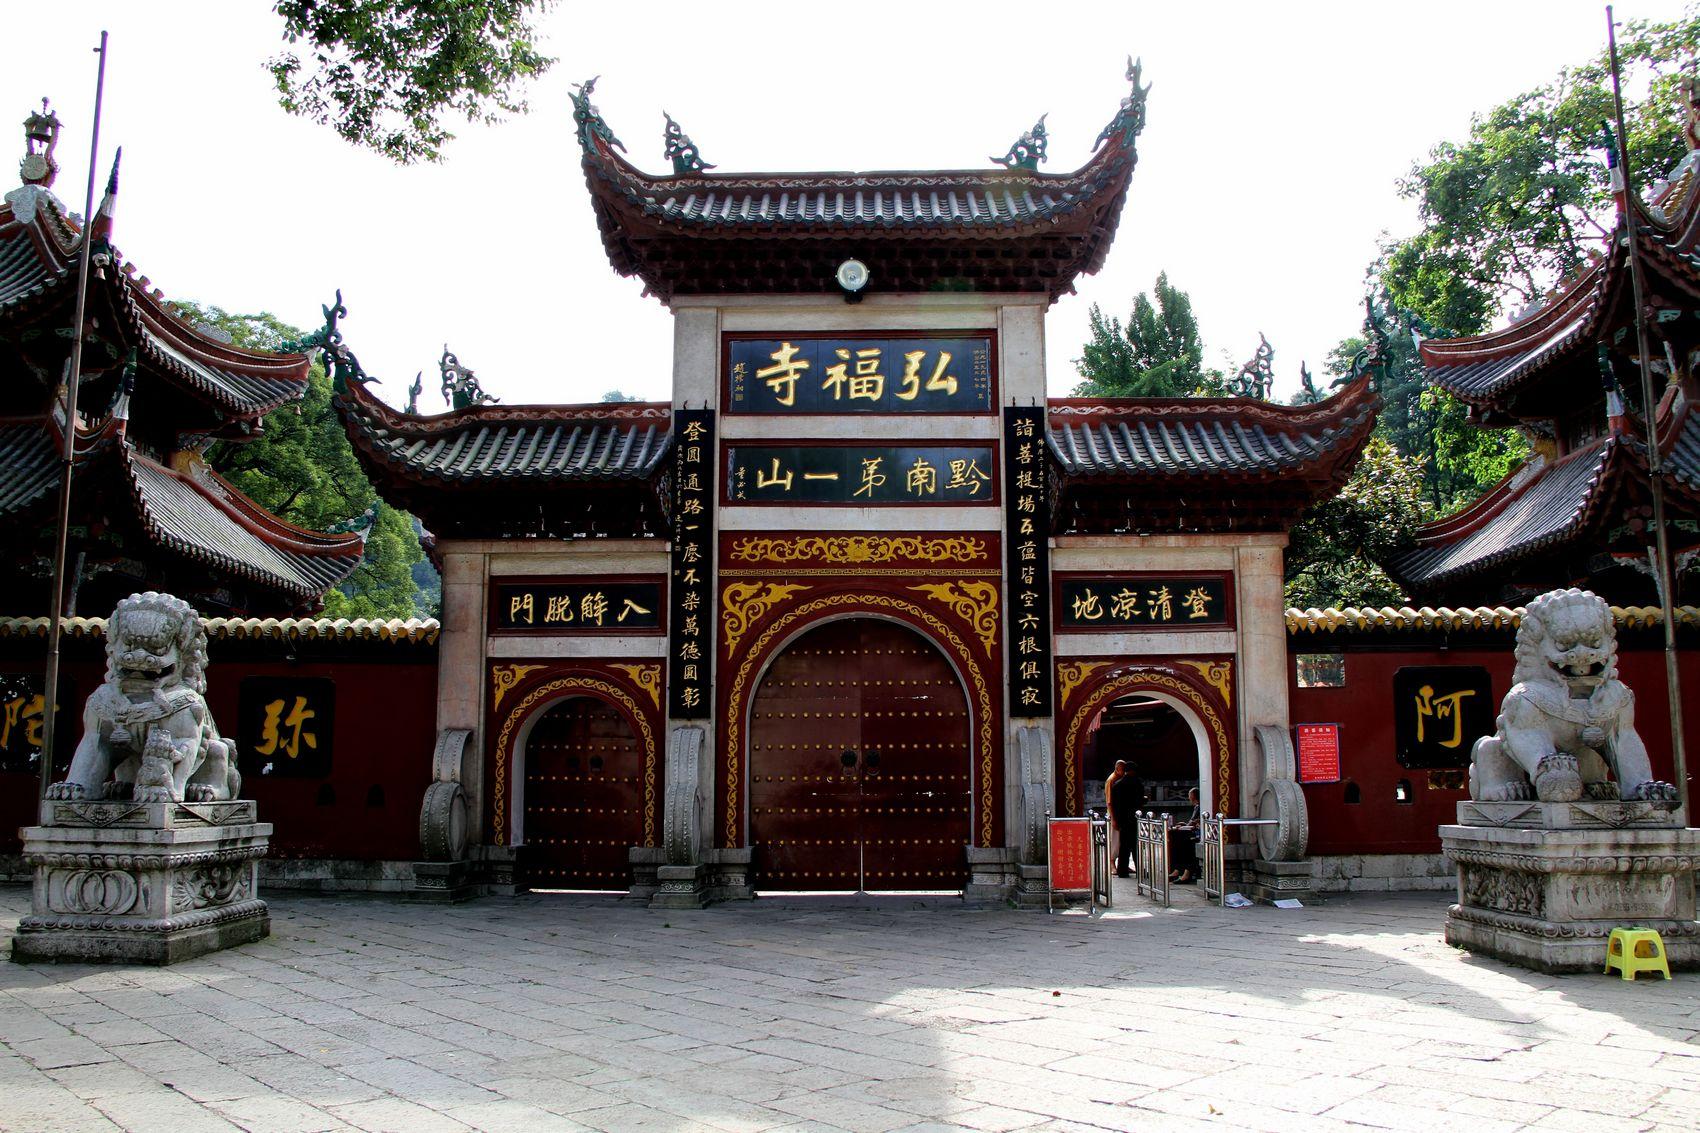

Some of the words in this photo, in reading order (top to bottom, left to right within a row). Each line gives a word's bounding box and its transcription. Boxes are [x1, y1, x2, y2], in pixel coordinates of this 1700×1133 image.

[756, 342, 958, 406] 弘福寺
[254, 696, 317, 758] 弥
[1415, 684, 1475, 748] 阿
